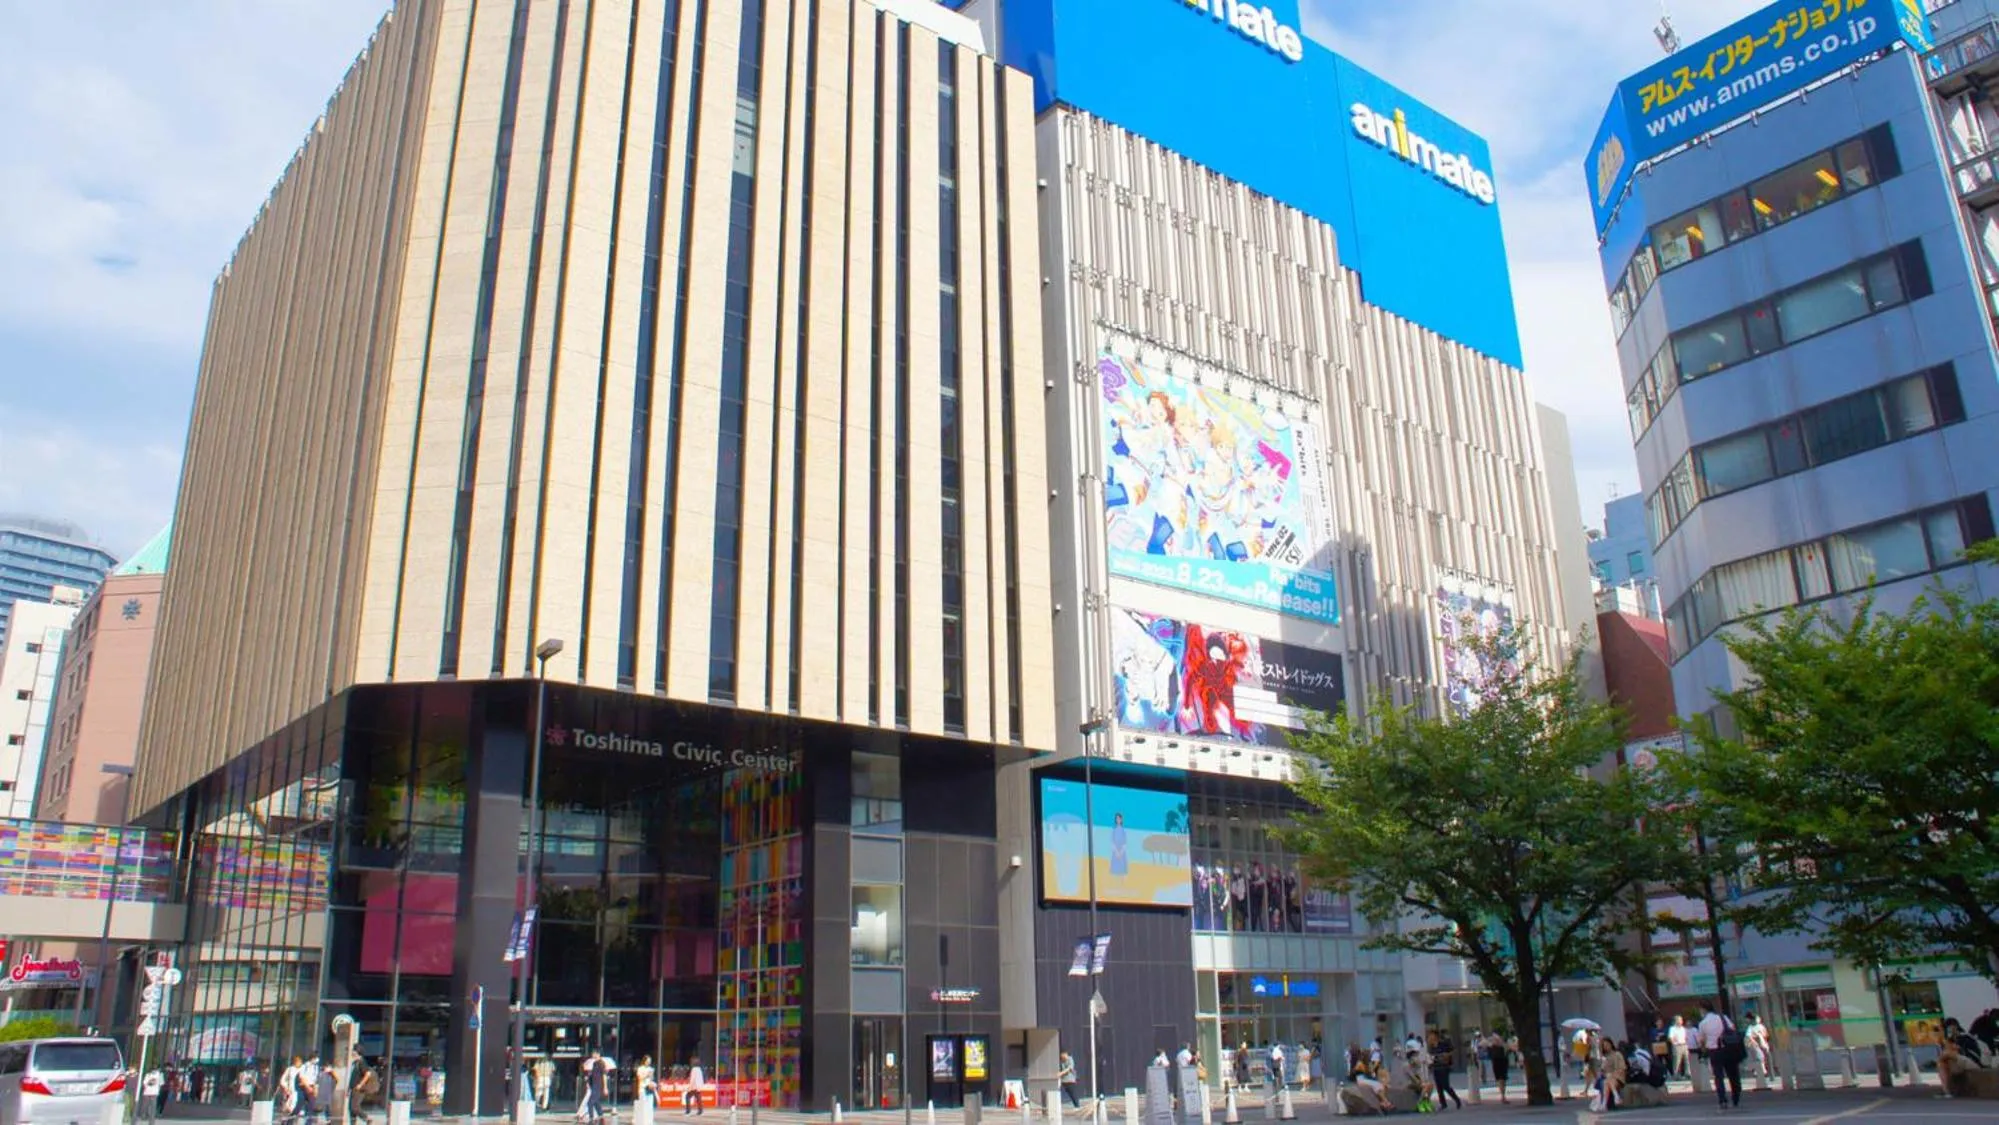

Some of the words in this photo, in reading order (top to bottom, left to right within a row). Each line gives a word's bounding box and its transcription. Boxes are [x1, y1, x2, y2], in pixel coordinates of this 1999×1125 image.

[1184, 0, 1303, 63] mate
[1645, 16, 1877, 138] www.amms.co.jp
[1350, 102, 1495, 205] animate
[1244, 660, 1334, 688] ストレイドッグス
[572, 728, 663, 757] Toshima
[673, 742, 721, 764] Civic
[731, 750, 796, 772] Center
